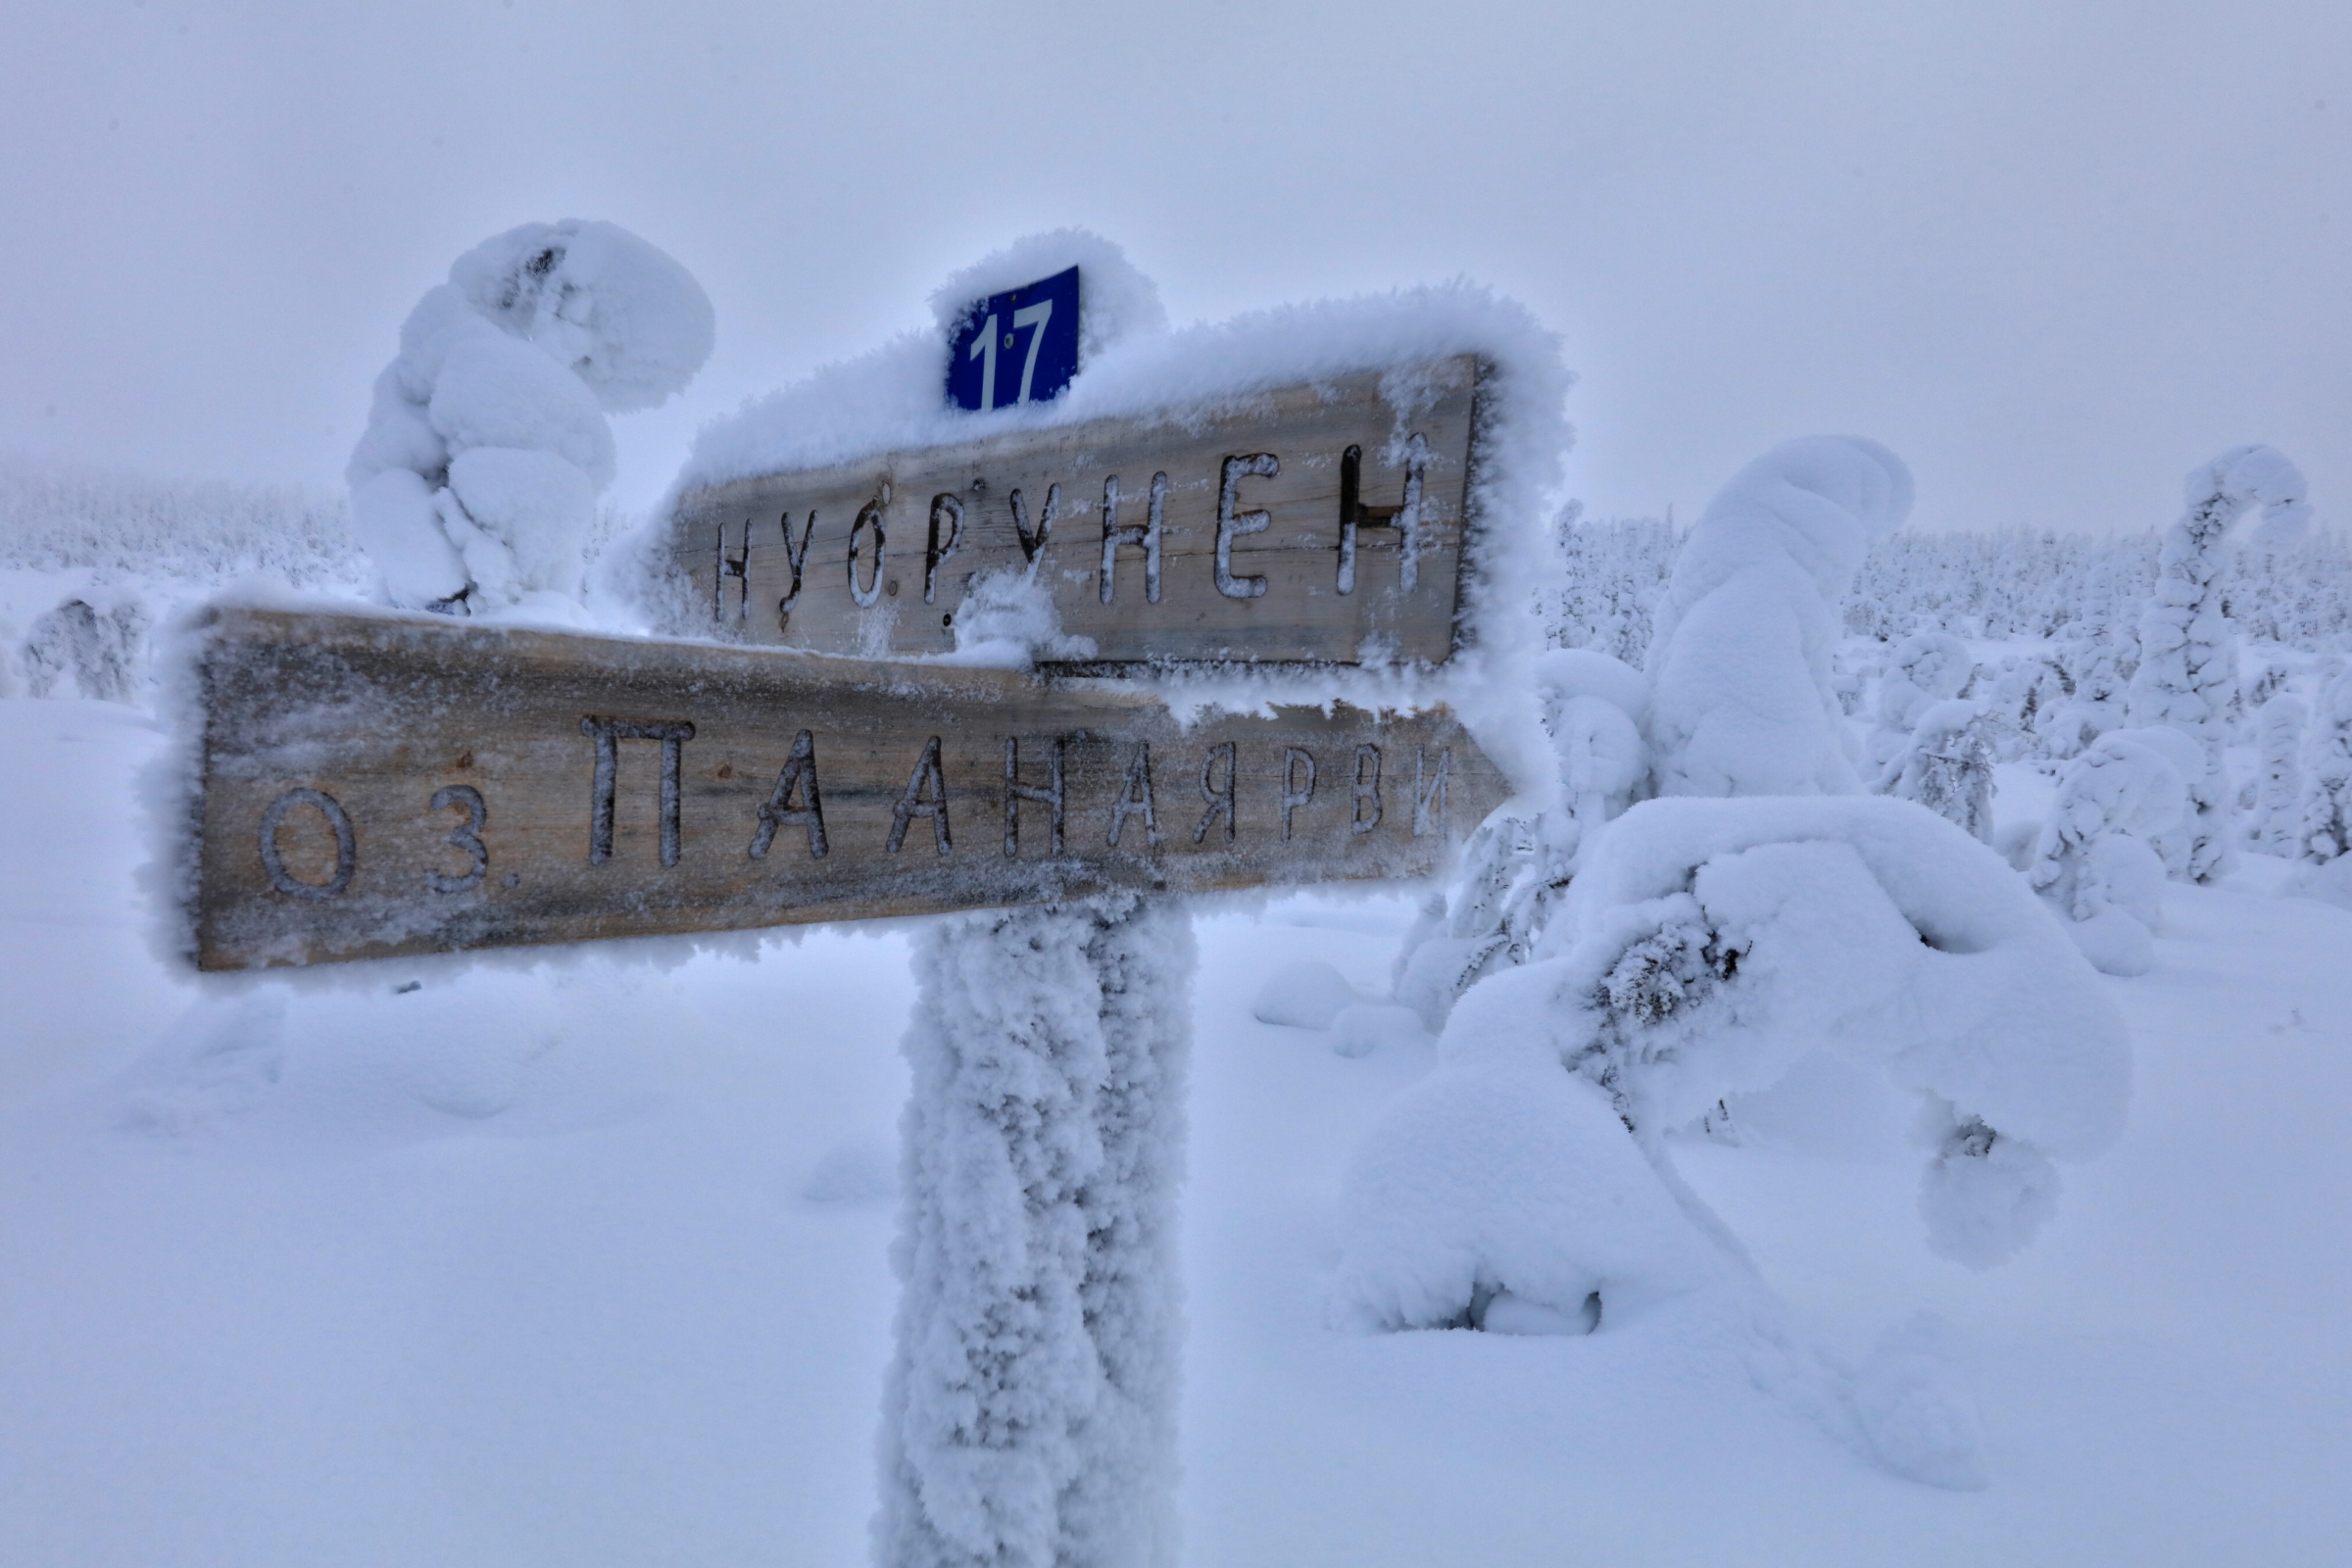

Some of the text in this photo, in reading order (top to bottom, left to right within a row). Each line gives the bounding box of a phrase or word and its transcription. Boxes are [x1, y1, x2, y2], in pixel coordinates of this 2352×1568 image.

[970, 299, 1053, 411] 17
[715, 431, 1427, 621] НУОРУНЕН
[580, 714, 1451, 867] ПААНАЯРВИ
